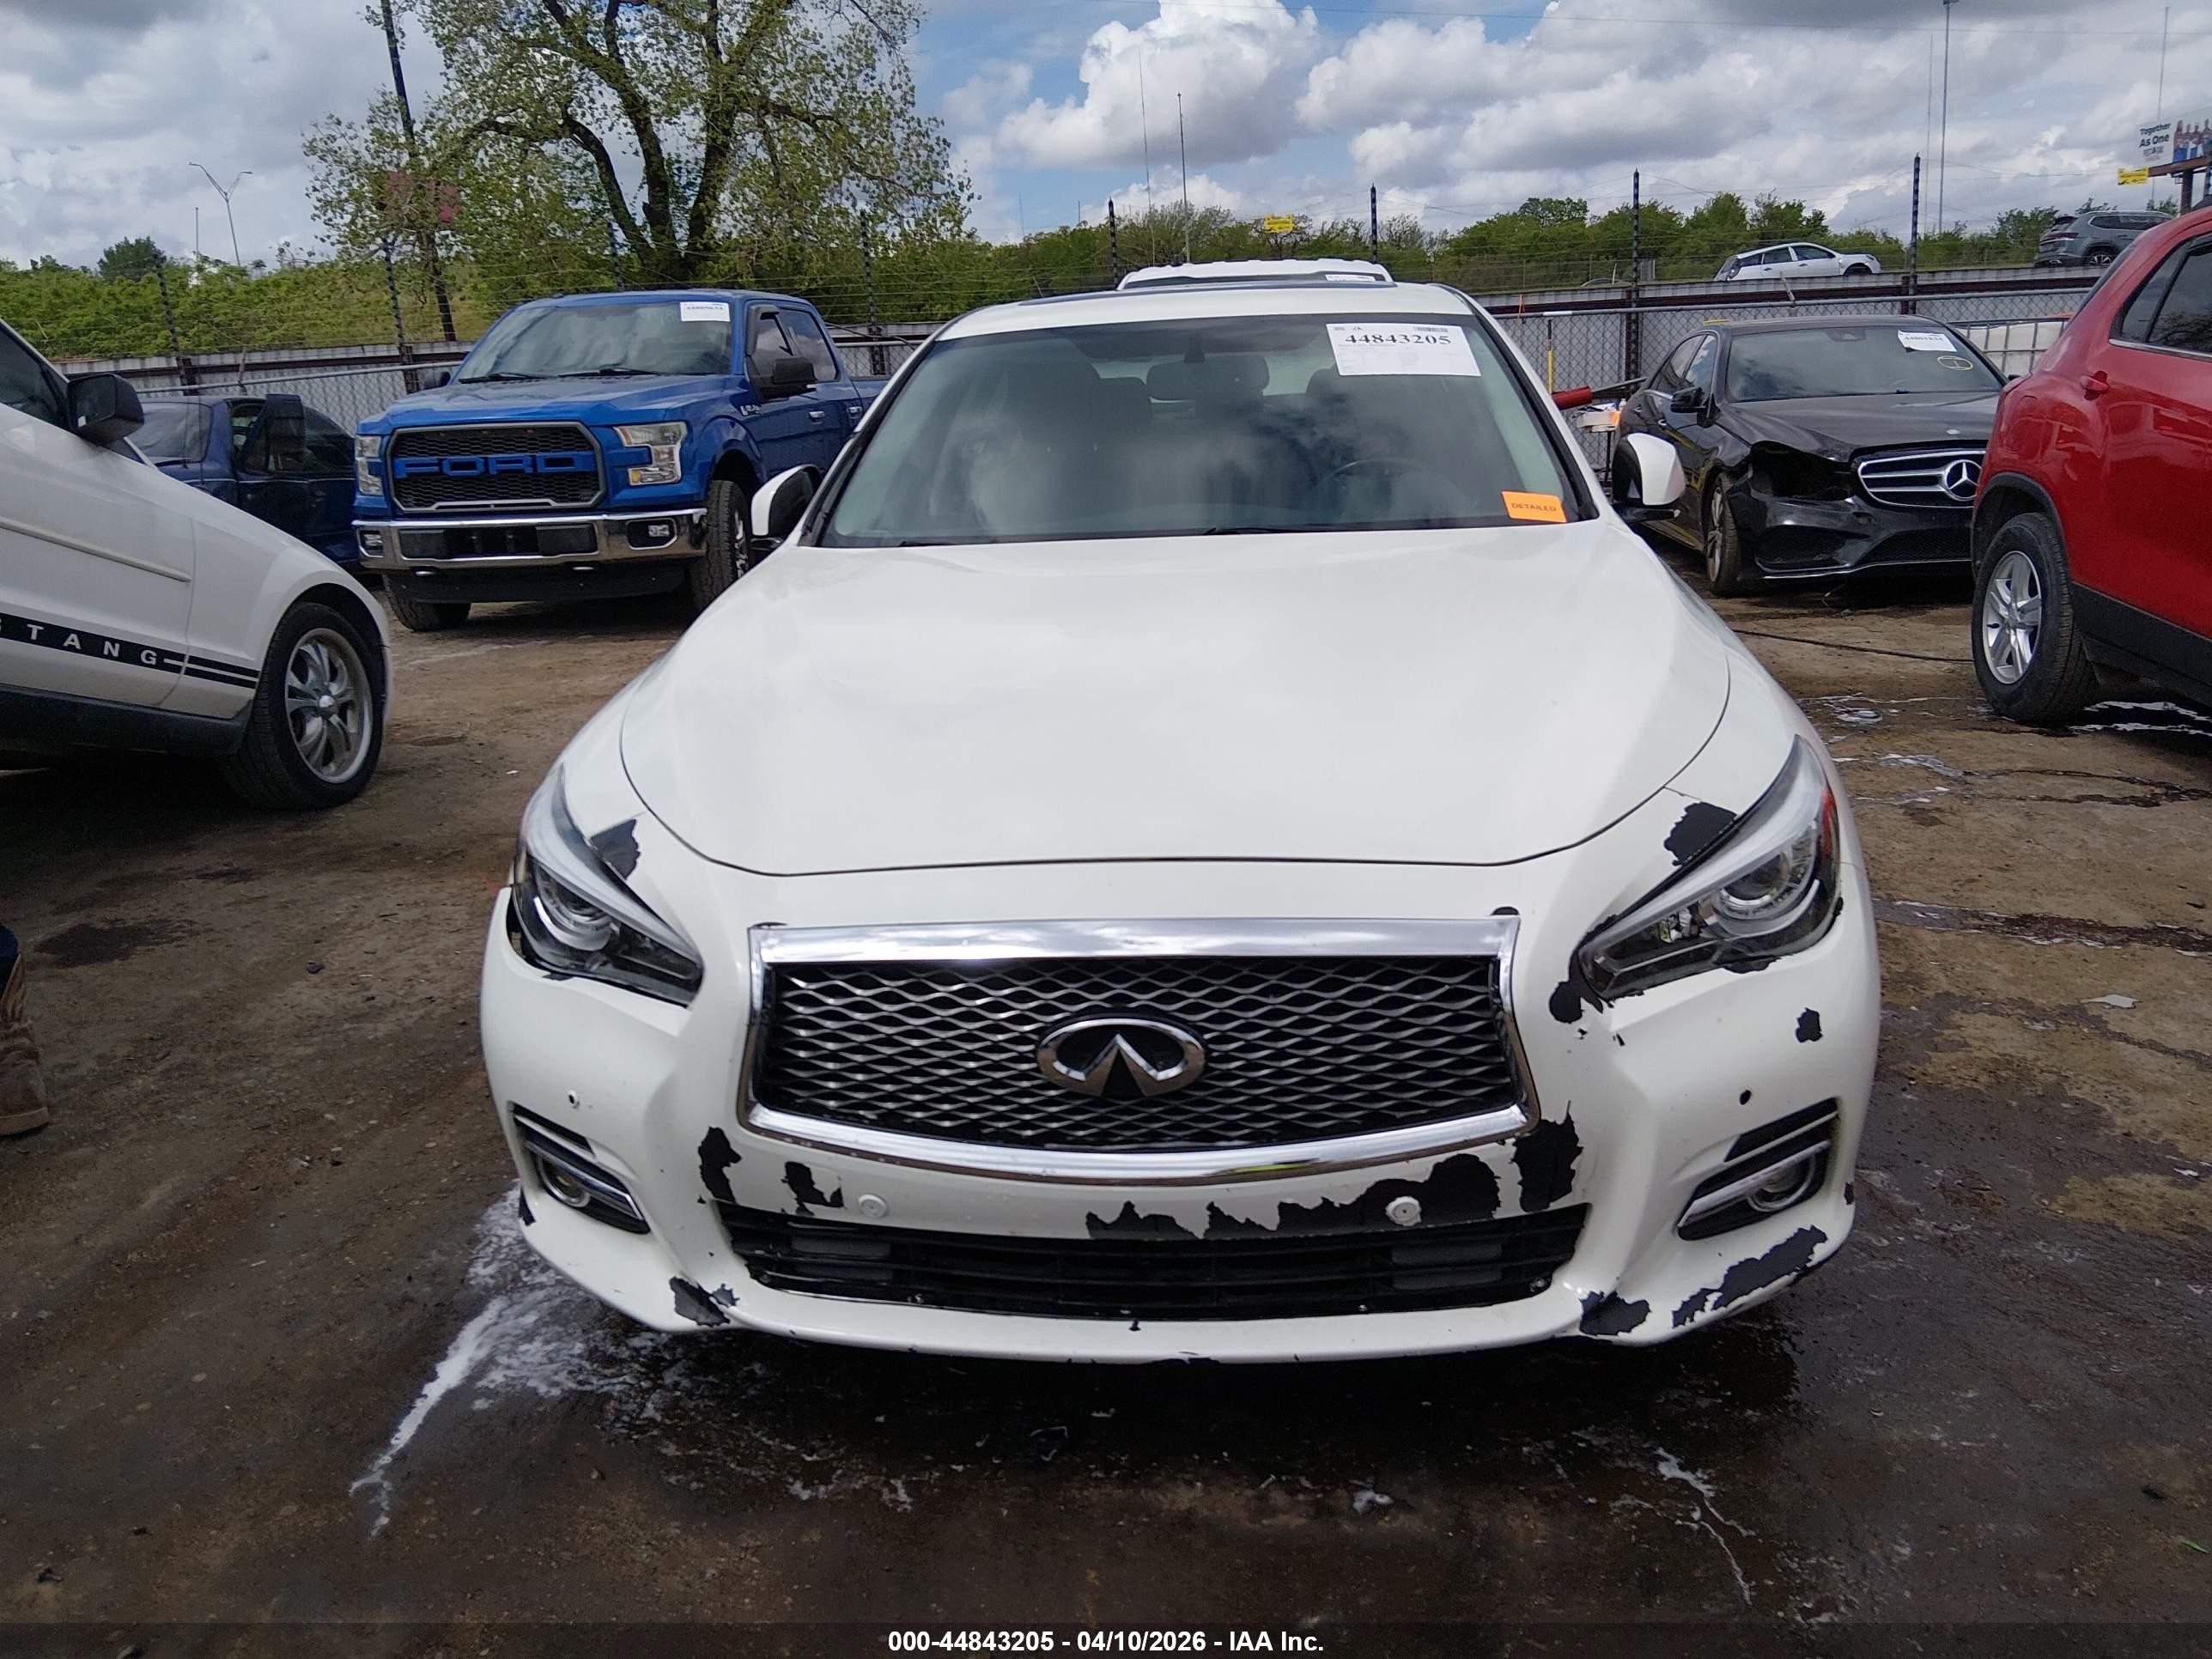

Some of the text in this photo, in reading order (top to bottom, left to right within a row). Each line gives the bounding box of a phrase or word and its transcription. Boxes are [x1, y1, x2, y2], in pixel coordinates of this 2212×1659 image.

[2140, 123, 2171, 135] Together
[2140, 134, 2170, 147] As One
[1345, 334, 1451, 344] 44843205
[394, 452, 594, 478] FORD
[1511, 502, 1557, 512] DETAILED
[0, 618, 157, 665] TANG
